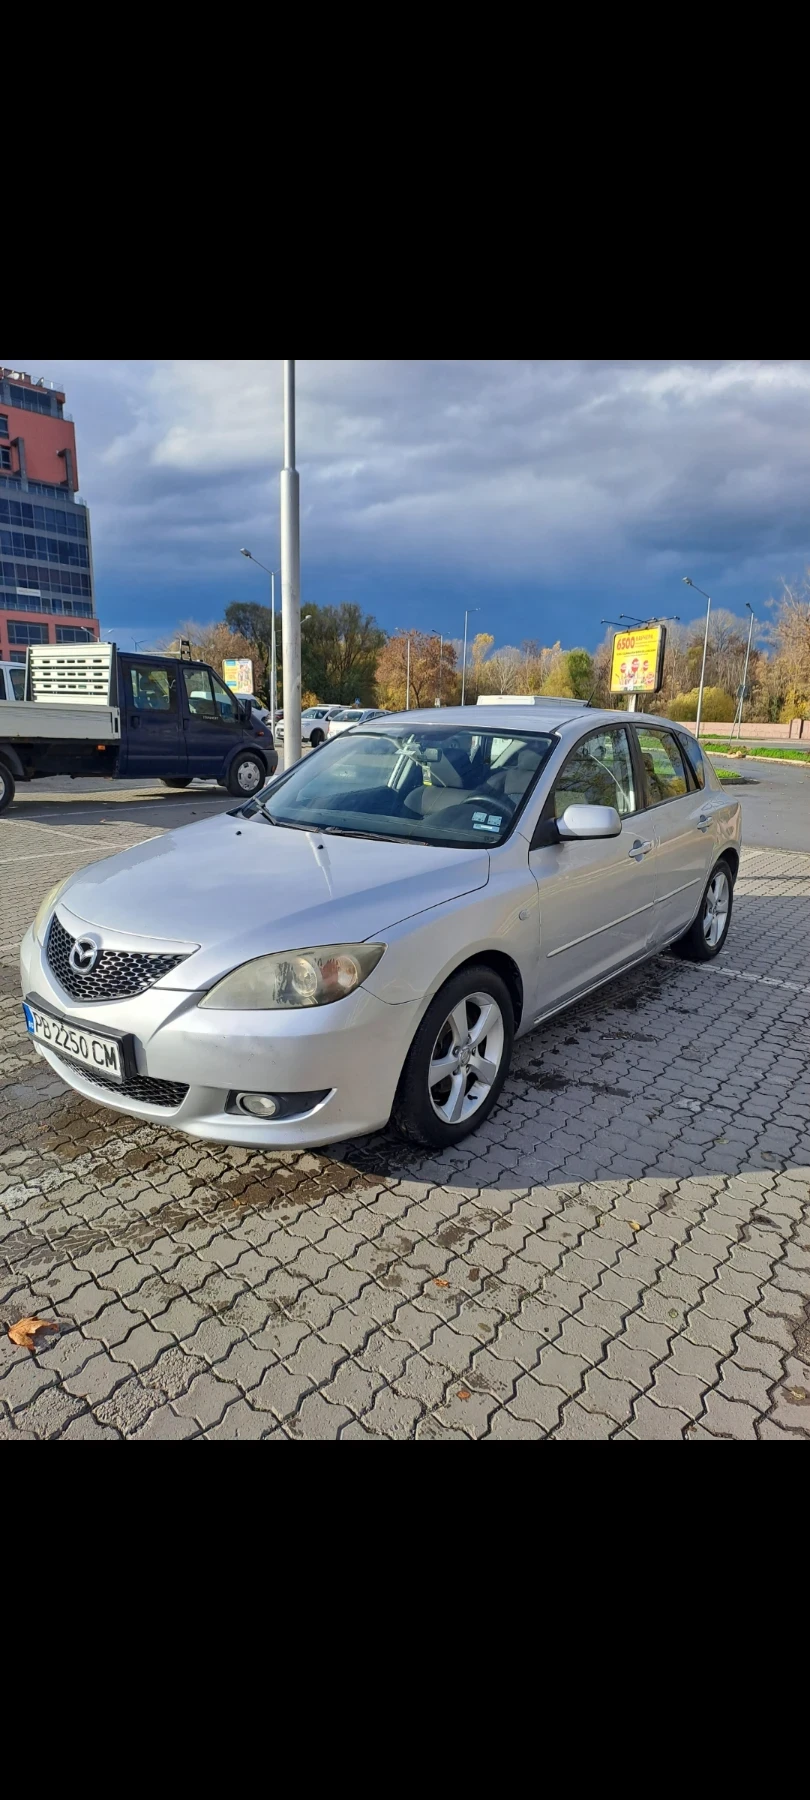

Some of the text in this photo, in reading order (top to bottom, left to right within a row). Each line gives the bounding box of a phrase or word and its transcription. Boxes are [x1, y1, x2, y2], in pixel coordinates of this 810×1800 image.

[616, 636, 635, 650] 6500
[33, 1012, 118, 1071] PB 2250 CM
